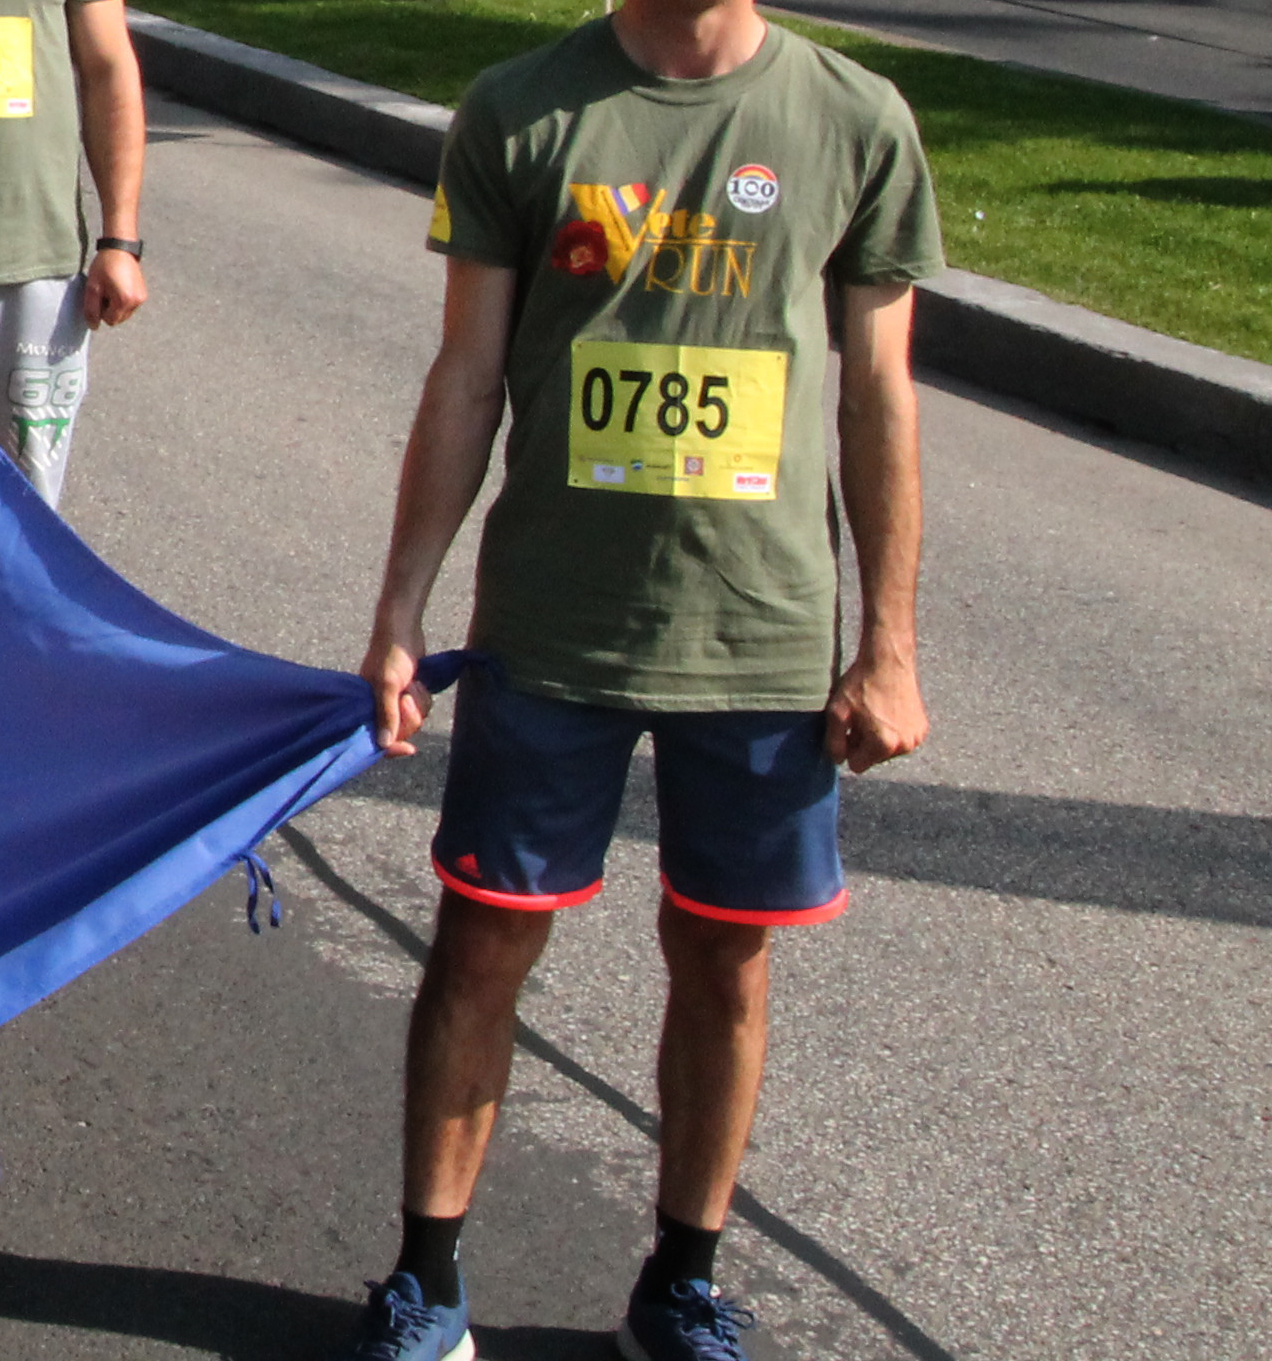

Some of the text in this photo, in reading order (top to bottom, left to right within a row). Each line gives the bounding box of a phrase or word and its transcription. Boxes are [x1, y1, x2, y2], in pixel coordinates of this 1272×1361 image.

[729, 179, 776, 198] 100
[645, 245, 754, 298] RUN
[581, 367, 729, 439] 0785
